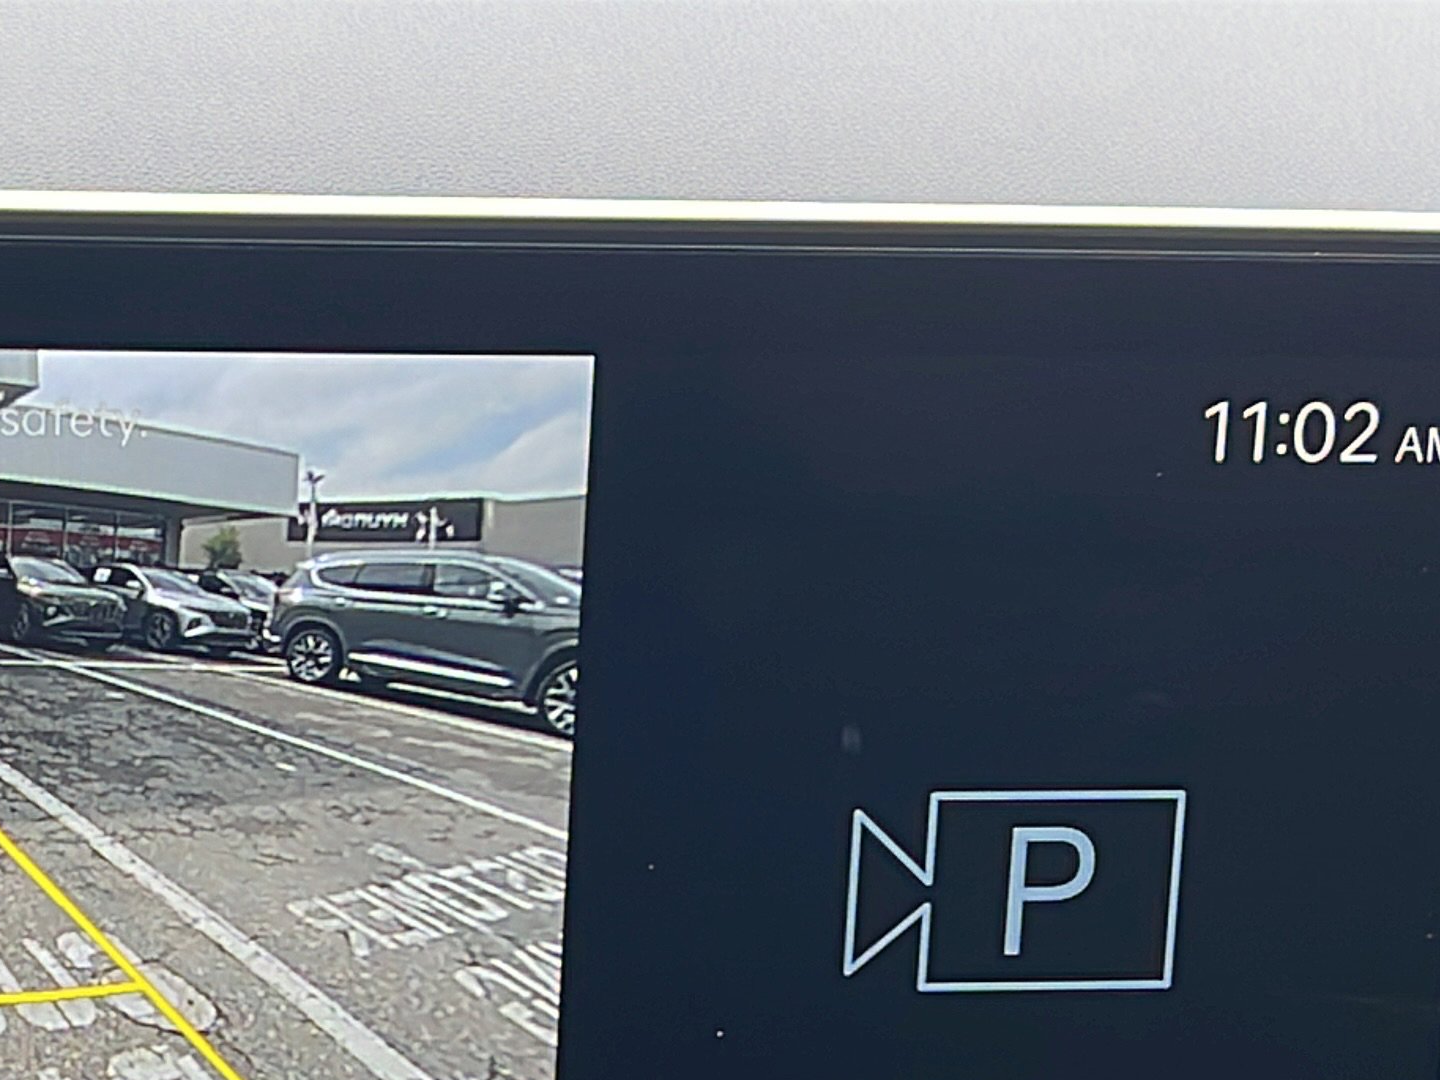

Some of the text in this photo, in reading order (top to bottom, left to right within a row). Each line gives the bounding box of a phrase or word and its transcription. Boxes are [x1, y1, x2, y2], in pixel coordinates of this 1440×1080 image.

[0, 402, 149, 447] safety.
[1204, 401, 1380, 464] 11:02
[1003, 826, 1096, 956] P
